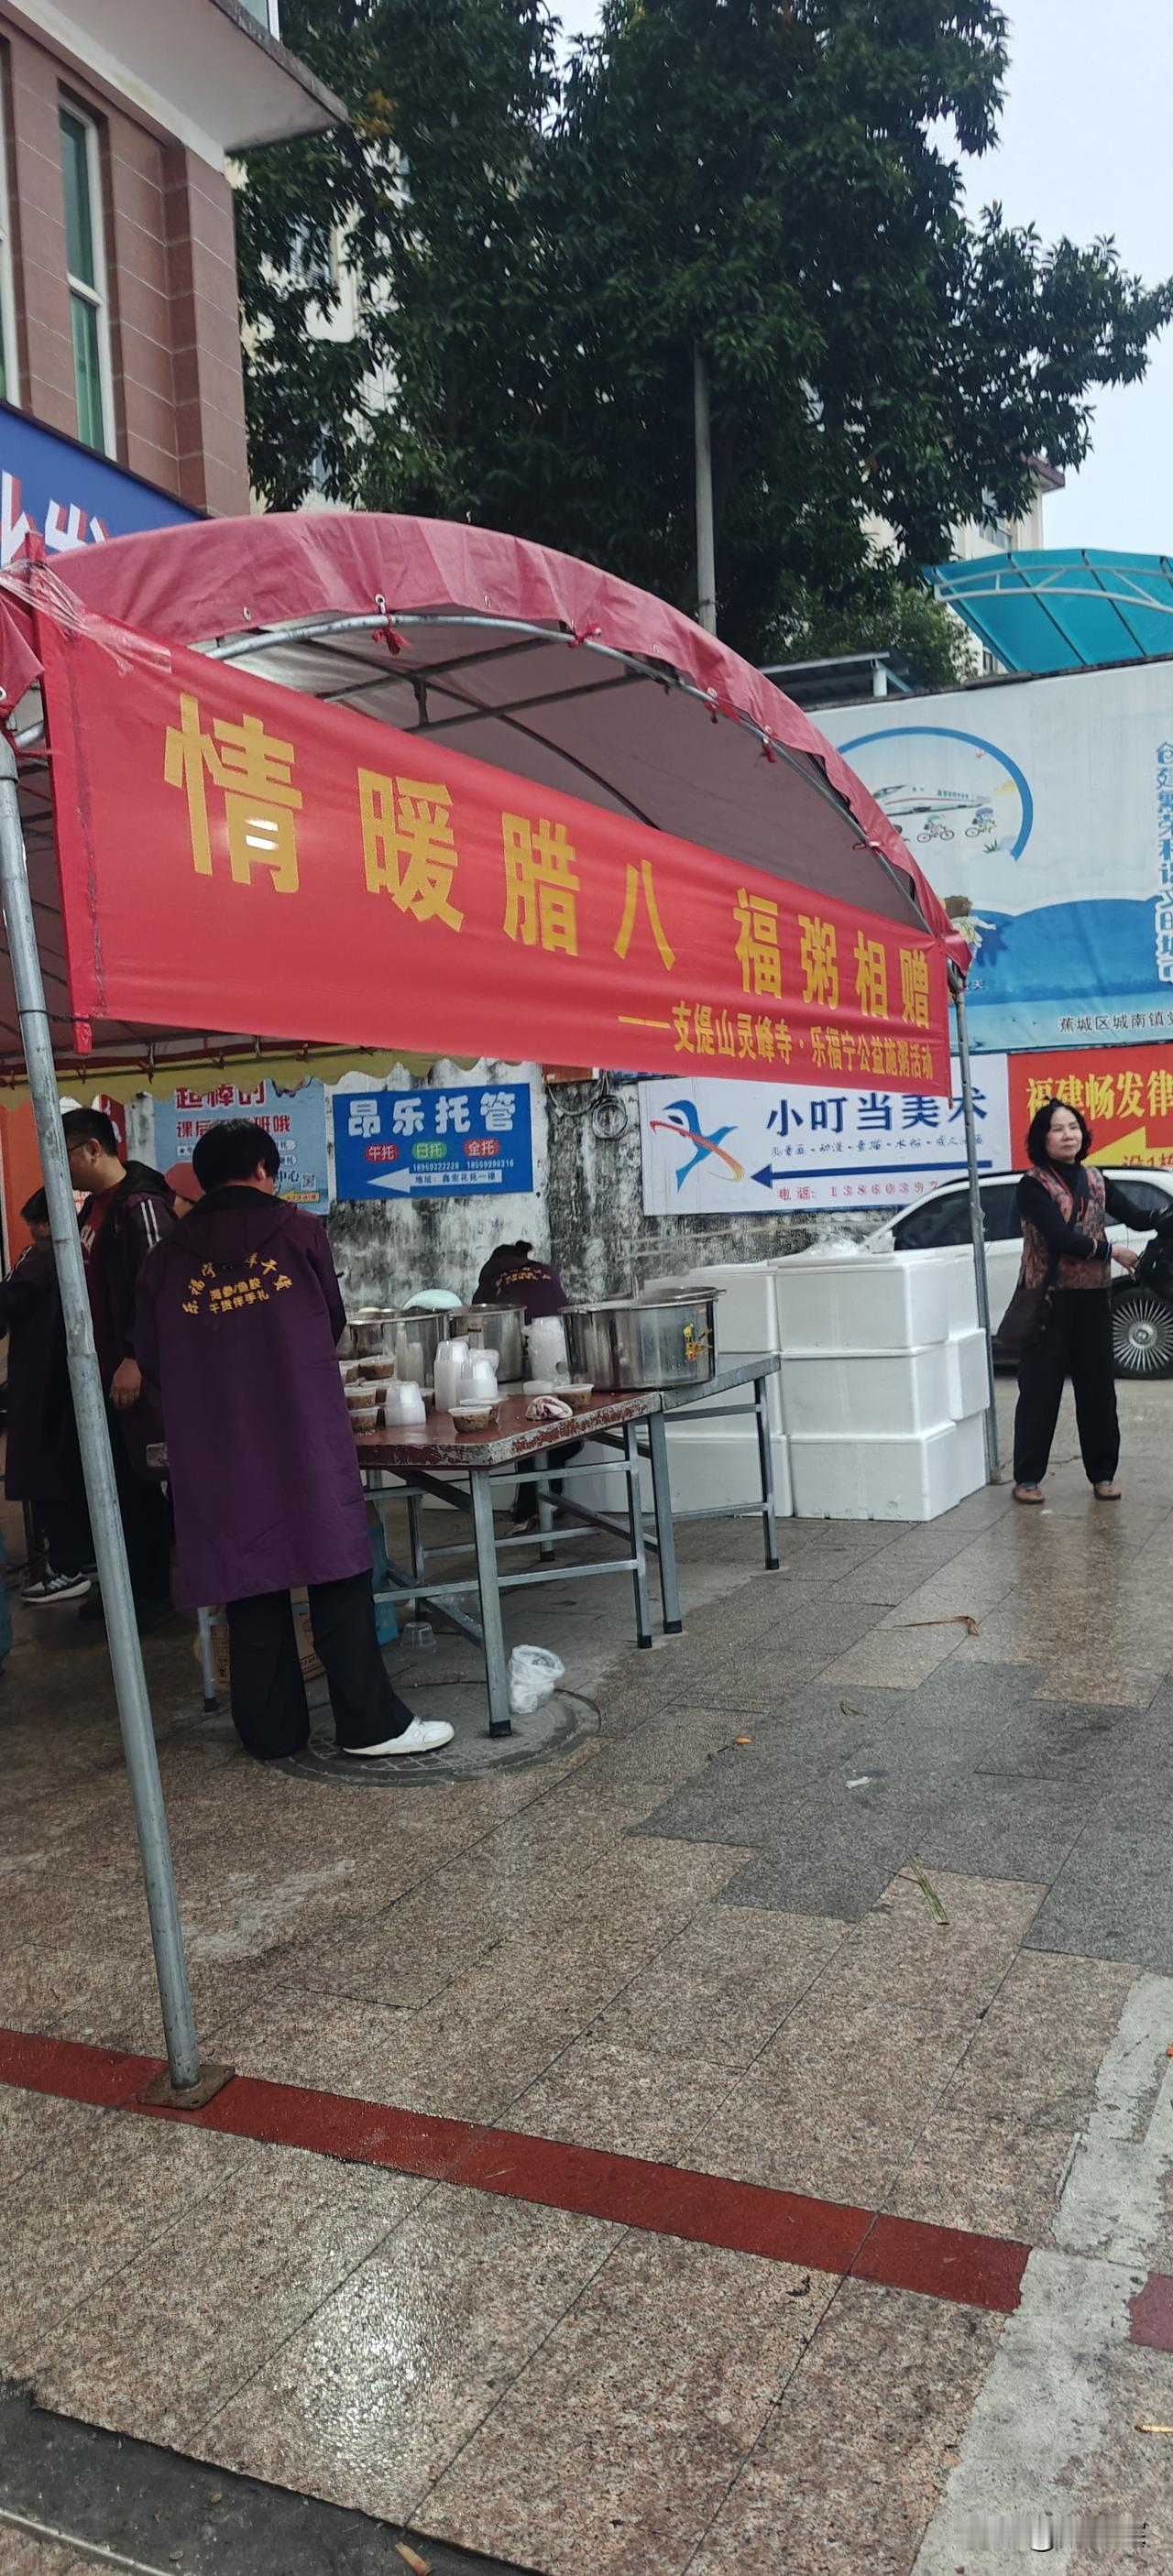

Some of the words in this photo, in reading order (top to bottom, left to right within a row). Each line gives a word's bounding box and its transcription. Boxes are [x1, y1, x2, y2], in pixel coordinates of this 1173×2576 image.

[164, 692, 676, 972] 情暖腊八
[732, 886, 930, 1030] 福粥相赠
[1059, 1010, 1173, 1033] 蕉城区城南镇
[176, 1114, 291, 1139] 课后班哦
[347, 1091, 516, 1138] 昂乐托管
[766, 1086, 988, 1137] 小叮当美术
[368, 1144, 395, 1161] 午托
[416, 1141, 443, 1159] 日托
[468, 1139, 495, 1156] 全托
